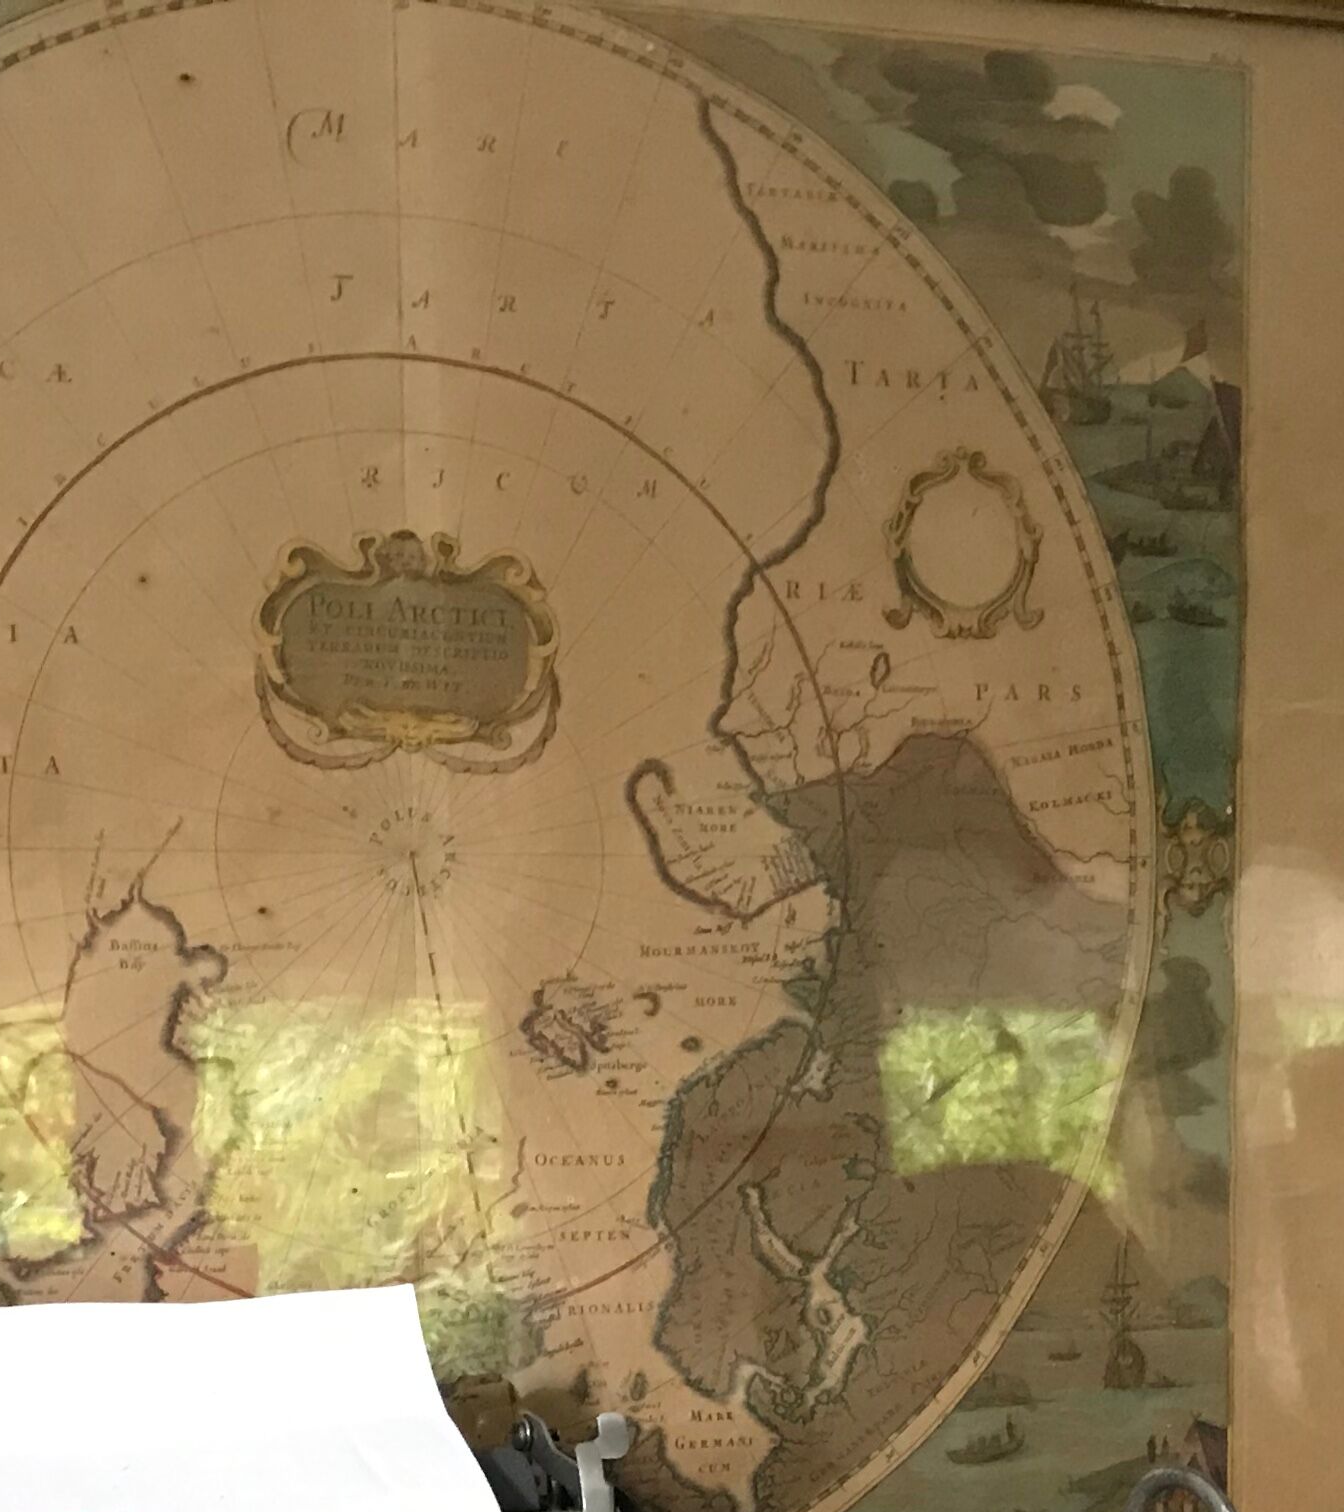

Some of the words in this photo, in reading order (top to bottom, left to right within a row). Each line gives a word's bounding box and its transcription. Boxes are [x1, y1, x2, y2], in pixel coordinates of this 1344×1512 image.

[307, 593, 374, 620] POLI
[974, 681, 1085, 703] PARS
[534, 1152, 626, 1168] OCEANUS
[557, 1229, 631, 1242] SEPTEN
